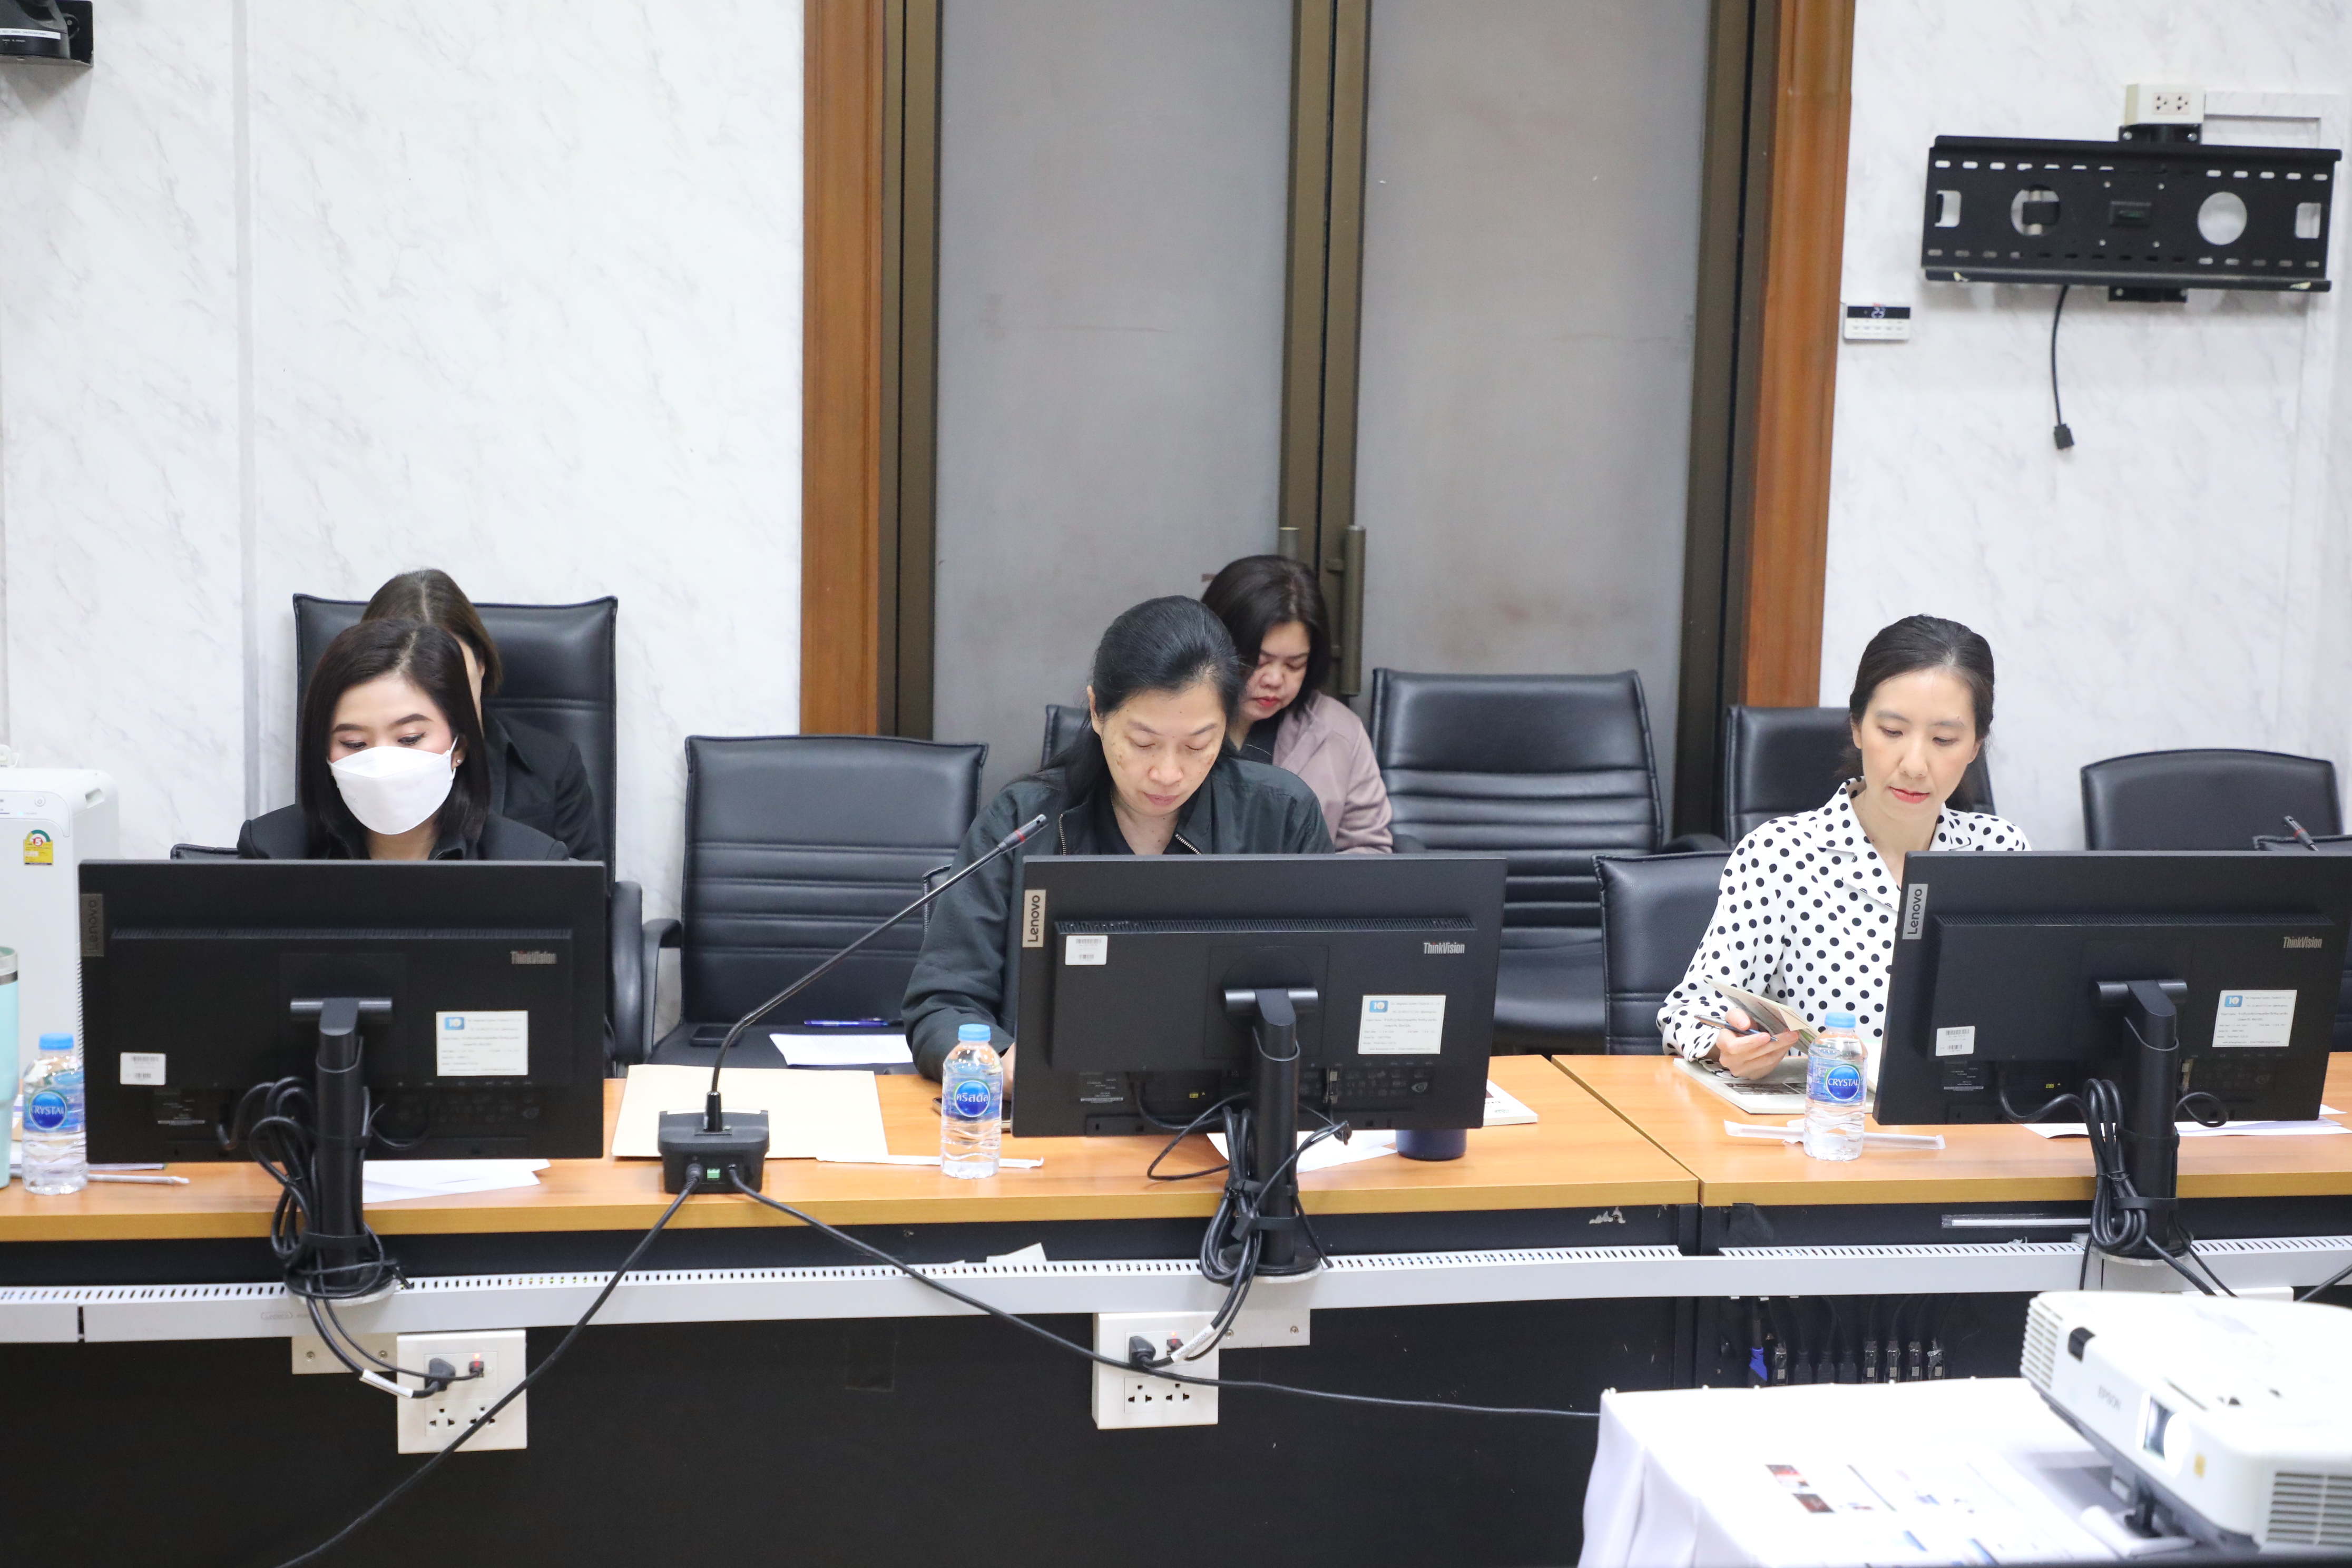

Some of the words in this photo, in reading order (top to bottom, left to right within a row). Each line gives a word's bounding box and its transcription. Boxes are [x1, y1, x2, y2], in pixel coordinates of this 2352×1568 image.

[1027, 895, 1041, 942] Lenovo
[1907, 889, 1923, 935] Lenovo
[1424, 942, 1465, 954] ThinkVision
[2283, 936, 2322, 948] ThinkVision
[509, 950, 557, 965] ThinkVision
[1828, 1078, 1858, 1086] CRYSTAL
[956, 1093, 988, 1102] คริสตัล
[31, 1105, 64, 1115] CRYSTAL
[1177, 1346, 1190, 1357] MADE
[1194, 1332, 1208, 1344] CHINA
[2098, 1385, 2122, 1412] EPSON
